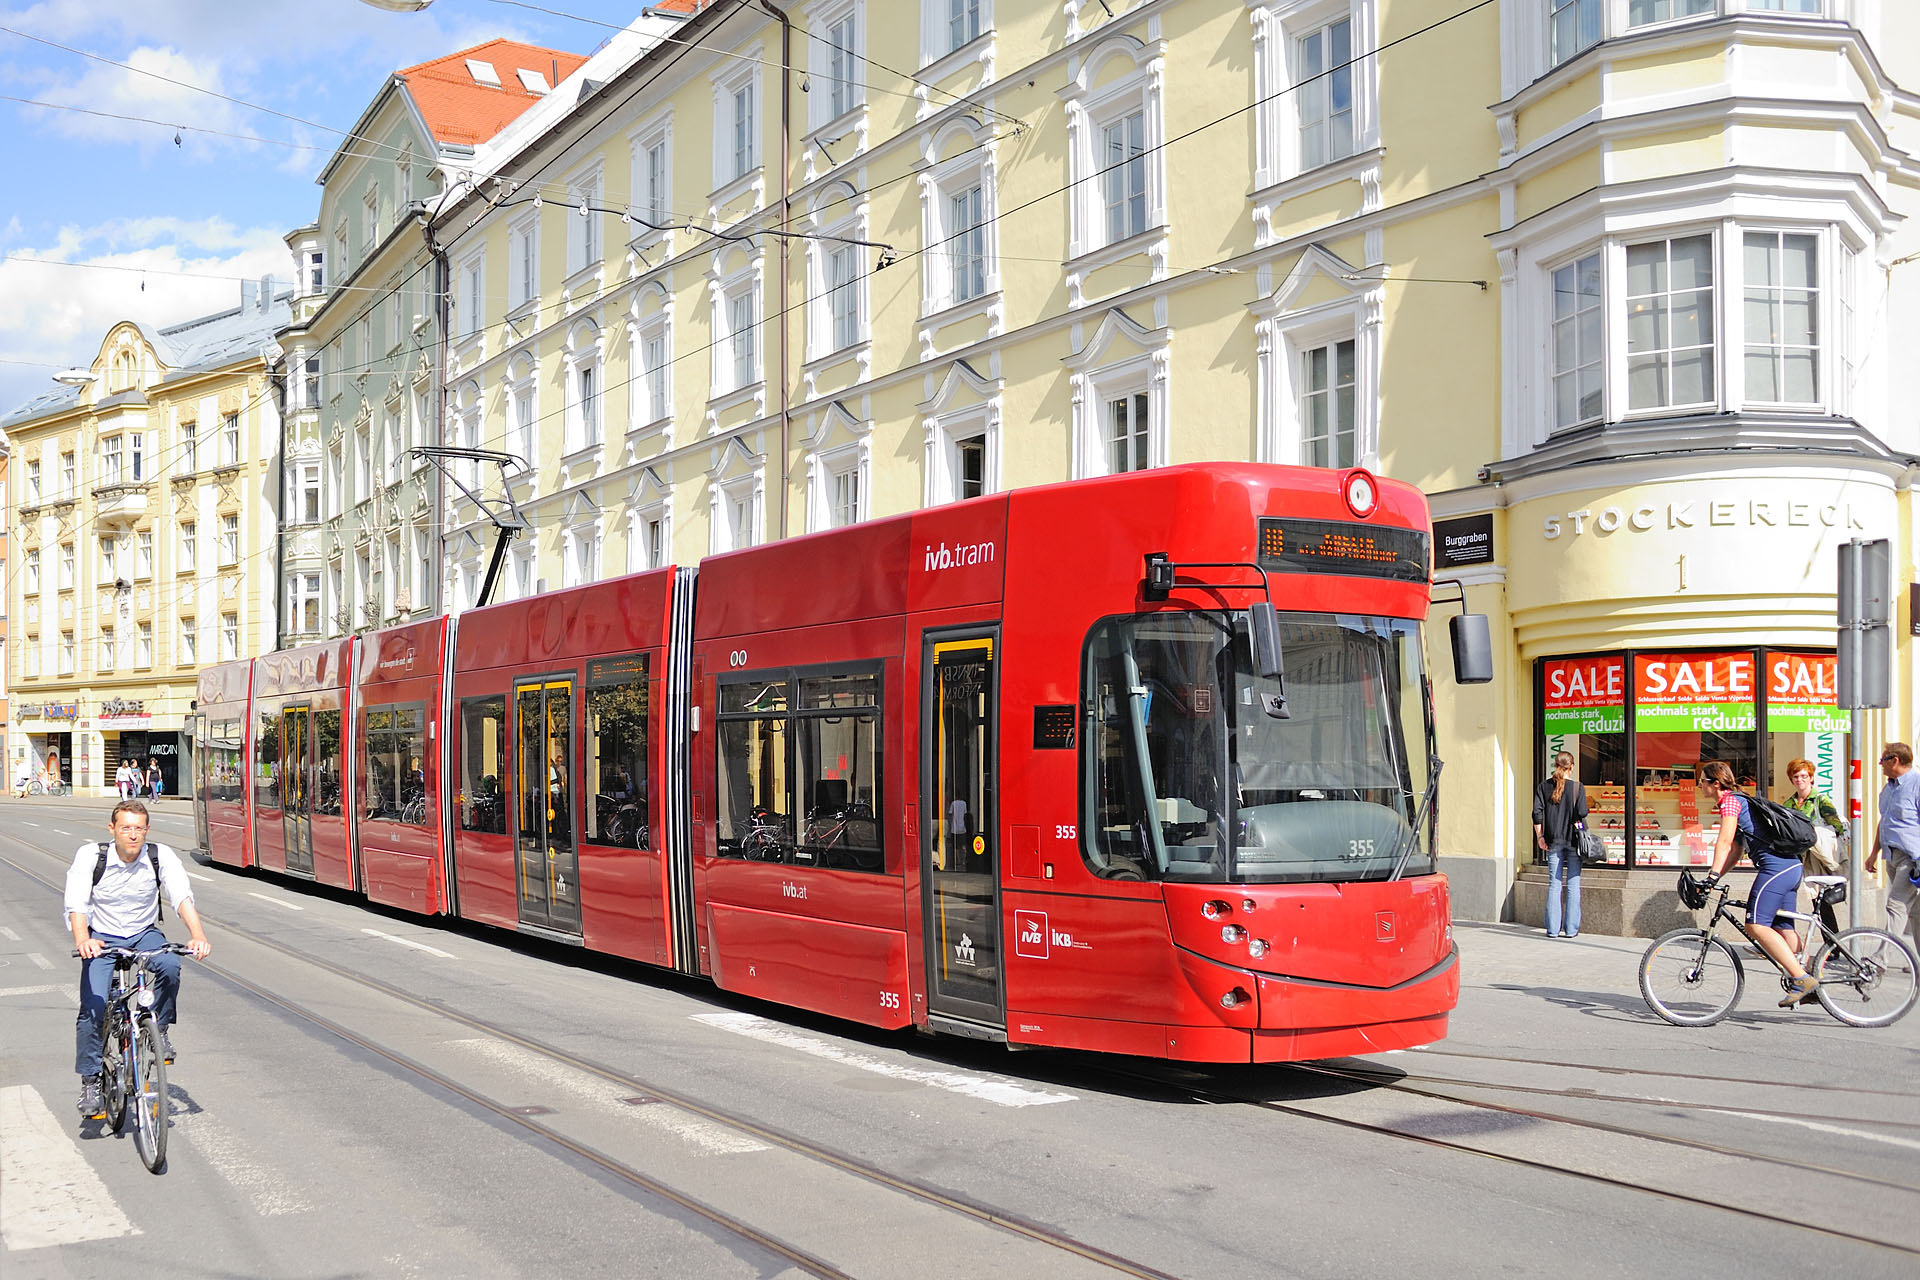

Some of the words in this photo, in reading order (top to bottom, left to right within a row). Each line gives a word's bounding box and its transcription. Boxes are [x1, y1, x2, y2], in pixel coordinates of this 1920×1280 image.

[1544, 500, 1864, 540] STOCKERECK
[1445, 532, 1487, 546] Burggraben
[925, 542, 994, 571] ivb.tram
[1551, 665, 1621, 698] SALE
[1645, 661, 1750, 693] SALE
[1545, 710, 1579, 720] nochmals
[1581, 709, 1600, 718] stark
[1638, 705, 1688, 716] nochmals
[1691, 705, 1718, 715] stark
[1583, 715, 1624, 732] reduzi
[1056, 825, 1076, 839] 355
[1350, 840, 1374, 857] 355
[783, 881, 807, 899] ivb.at
[880, 991, 900, 1009] 355
